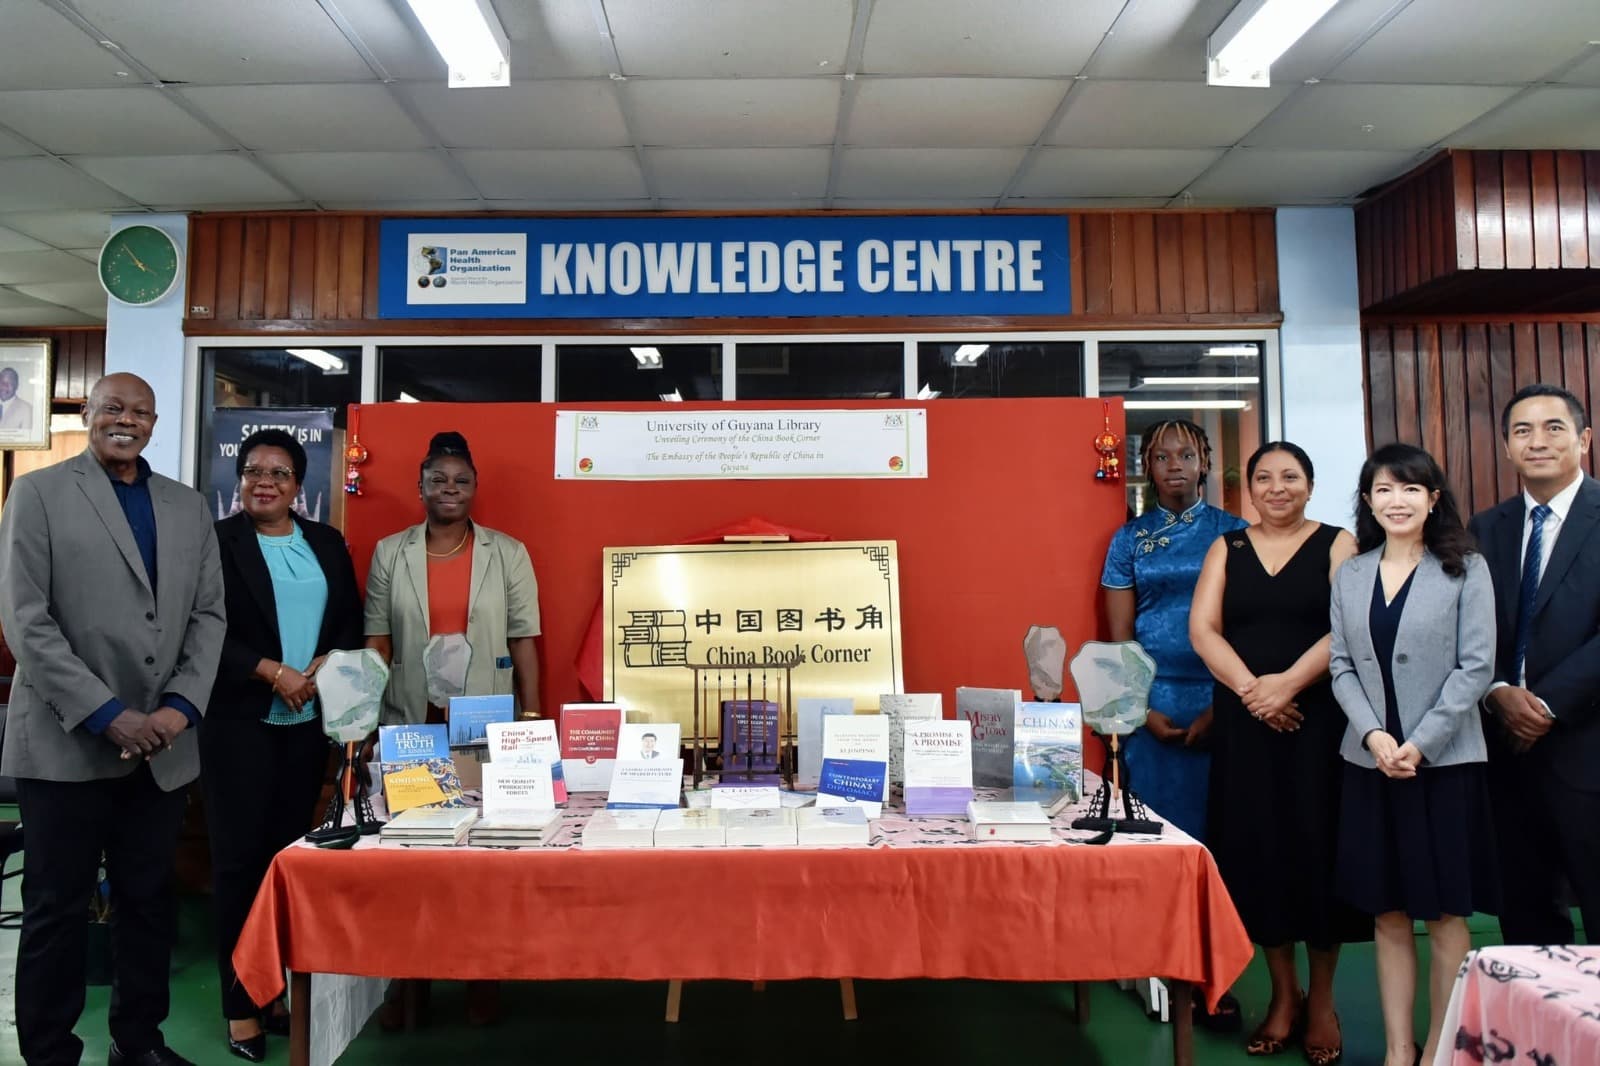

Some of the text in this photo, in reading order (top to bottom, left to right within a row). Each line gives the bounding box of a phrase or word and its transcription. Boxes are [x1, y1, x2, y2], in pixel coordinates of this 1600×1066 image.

[450, 265, 511, 273] Organization
[541, 240, 1044, 295] KNOWLEDGE CENTRE
[647, 419, 821, 434] University of Guyana Library
[297, 428, 308, 442] IS
[310, 428, 322, 442] IN
[655, 435, 691, 445] Unveiling
[692, 435, 728, 444] Ceremony
[728, 433, 738, 444] of
[752, 434, 774, 442] China
[647, 452, 660, 461] The
[662, 452, 693, 463] Embassy
[694, 451, 704, 462] of
[705, 451, 716, 460] the
[751, 451, 781, 462] Republic
[783, 451, 792, 462] of
[792, 451, 815, 460] China
[720, 463, 749, 473] Guyana
[695, 604, 883, 635] 中国图书角
[706, 643, 871, 664] China Book Corner
[395, 732, 420, 741] LIES
[501, 729, 533, 737] China's
[396, 740, 434, 750] TRUTH
[501, 736, 552, 744] High-Speed
[828, 773, 880, 784] CONTEMPORARY
[833, 779, 873, 790] CHINA'S
[826, 784, 878, 797] DIPLOMACY
